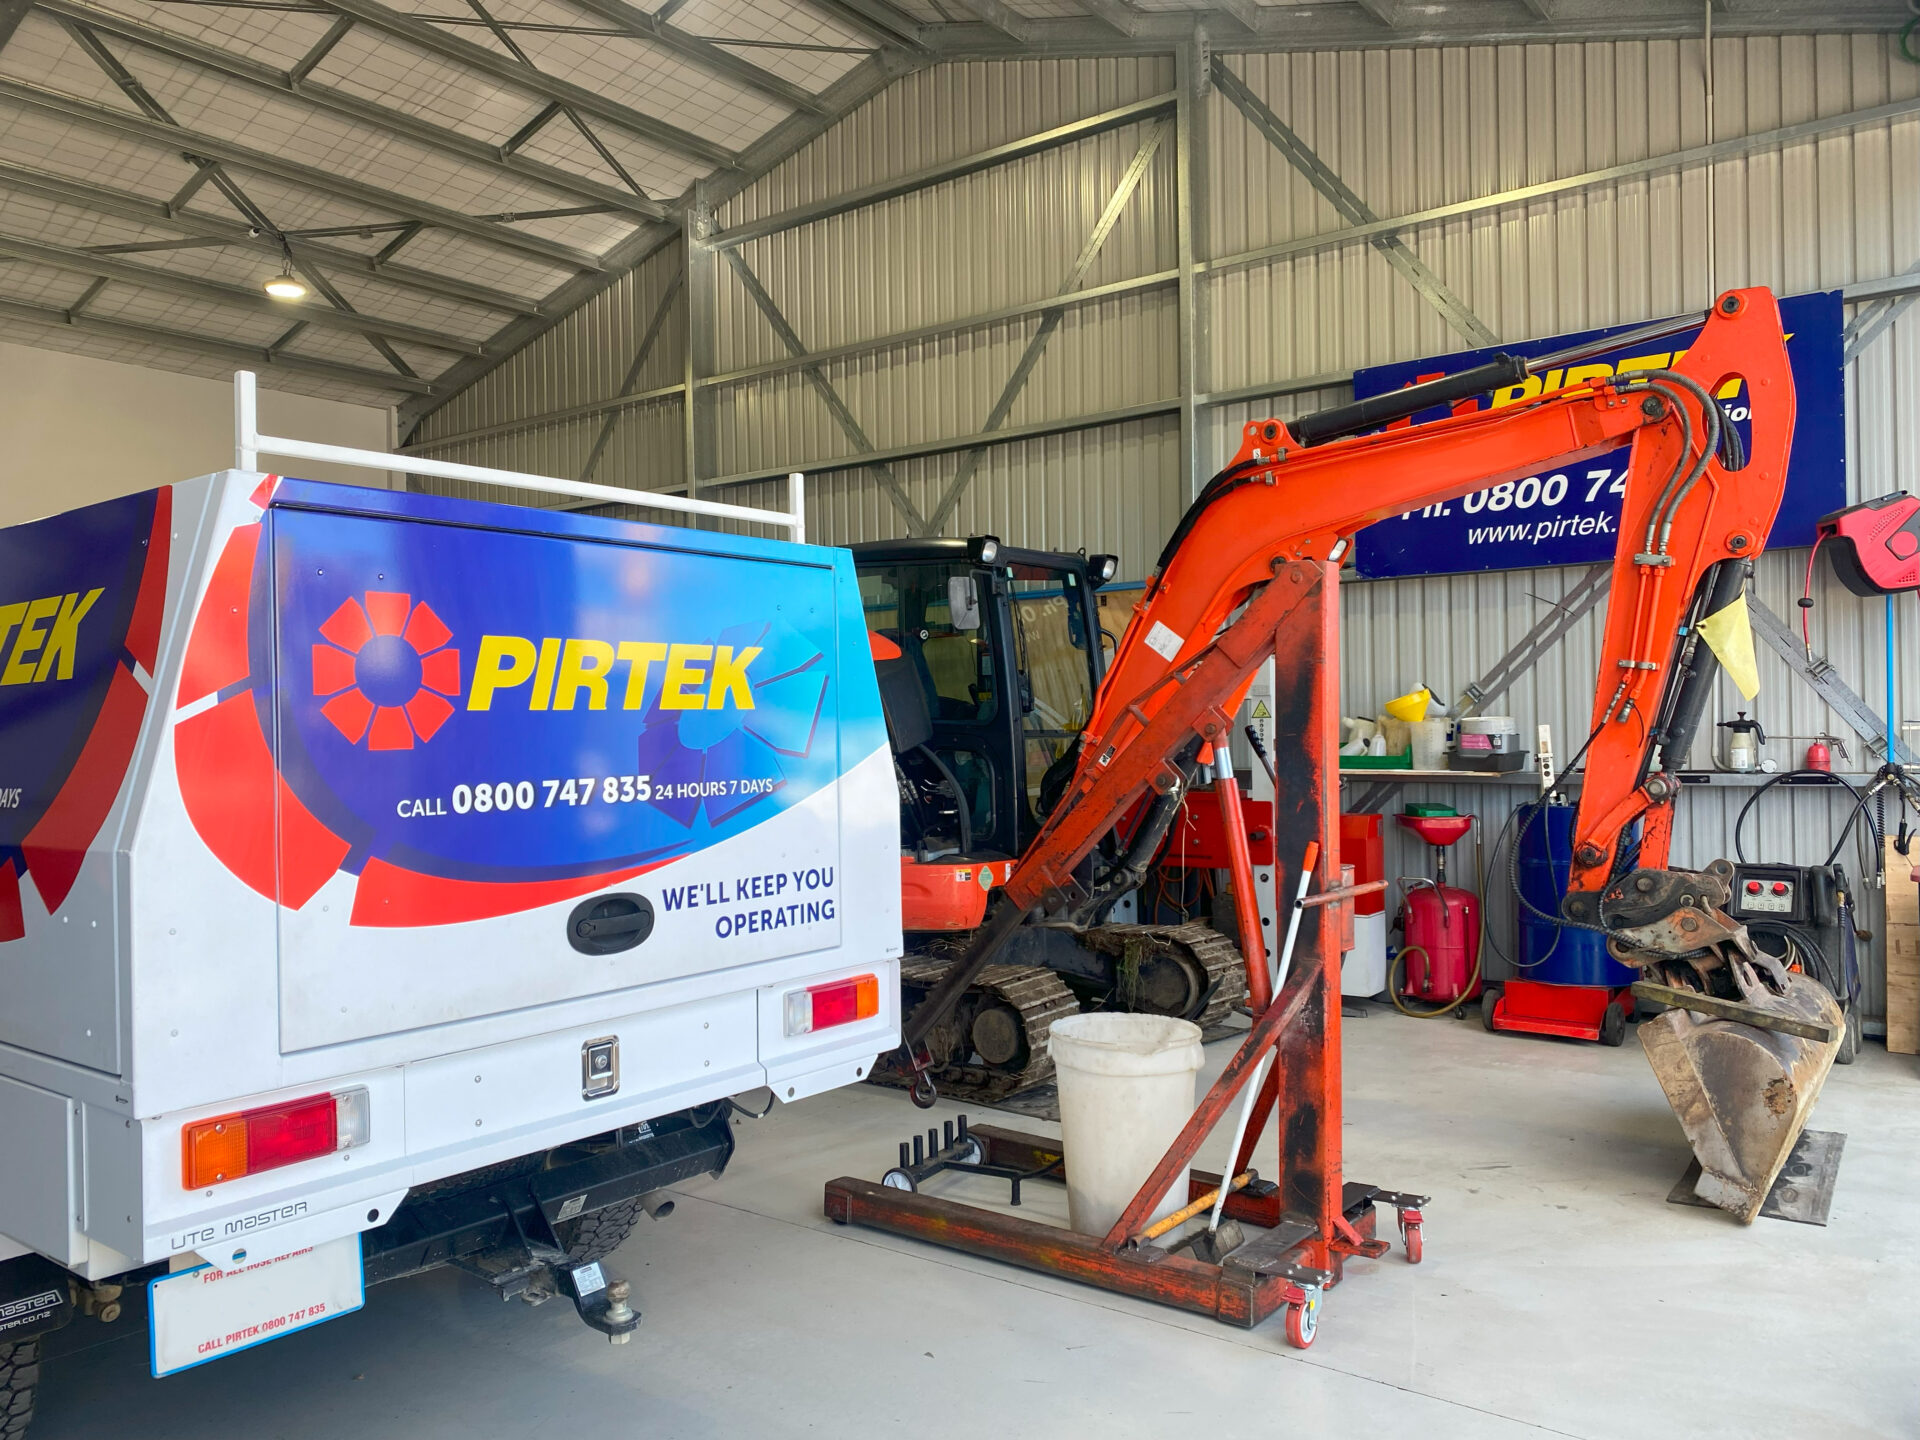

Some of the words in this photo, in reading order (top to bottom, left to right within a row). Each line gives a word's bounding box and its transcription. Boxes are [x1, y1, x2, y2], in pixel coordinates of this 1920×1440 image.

[1463, 474, 1568, 514] 0800
[466, 634, 764, 711] PIRTEK
[396, 797, 447, 818] CALL
[451, 780, 533, 814] 0800
[542, 777, 594, 808] 747
[601, 774, 652, 803] 835
[654, 784, 673, 800] 24
[676, 781, 727, 799] HOURS
[729, 780, 739, 796] 7
[740, 777, 774, 794] DAYS
[661, 881, 730, 912] WE'LL
[735, 871, 788, 901] KEEP
[791, 866, 835, 893] YOU
[715, 899, 836, 940] OPERATING
[203, 1269, 223, 1284] FOR
[197, 1338, 223, 1354] CALL
[225, 1324, 260, 1345] PIRTEK
[261, 1316, 286, 1332] 0800
[288, 1309, 306, 1323] 747
[308, 1302, 326, 1317] 835
